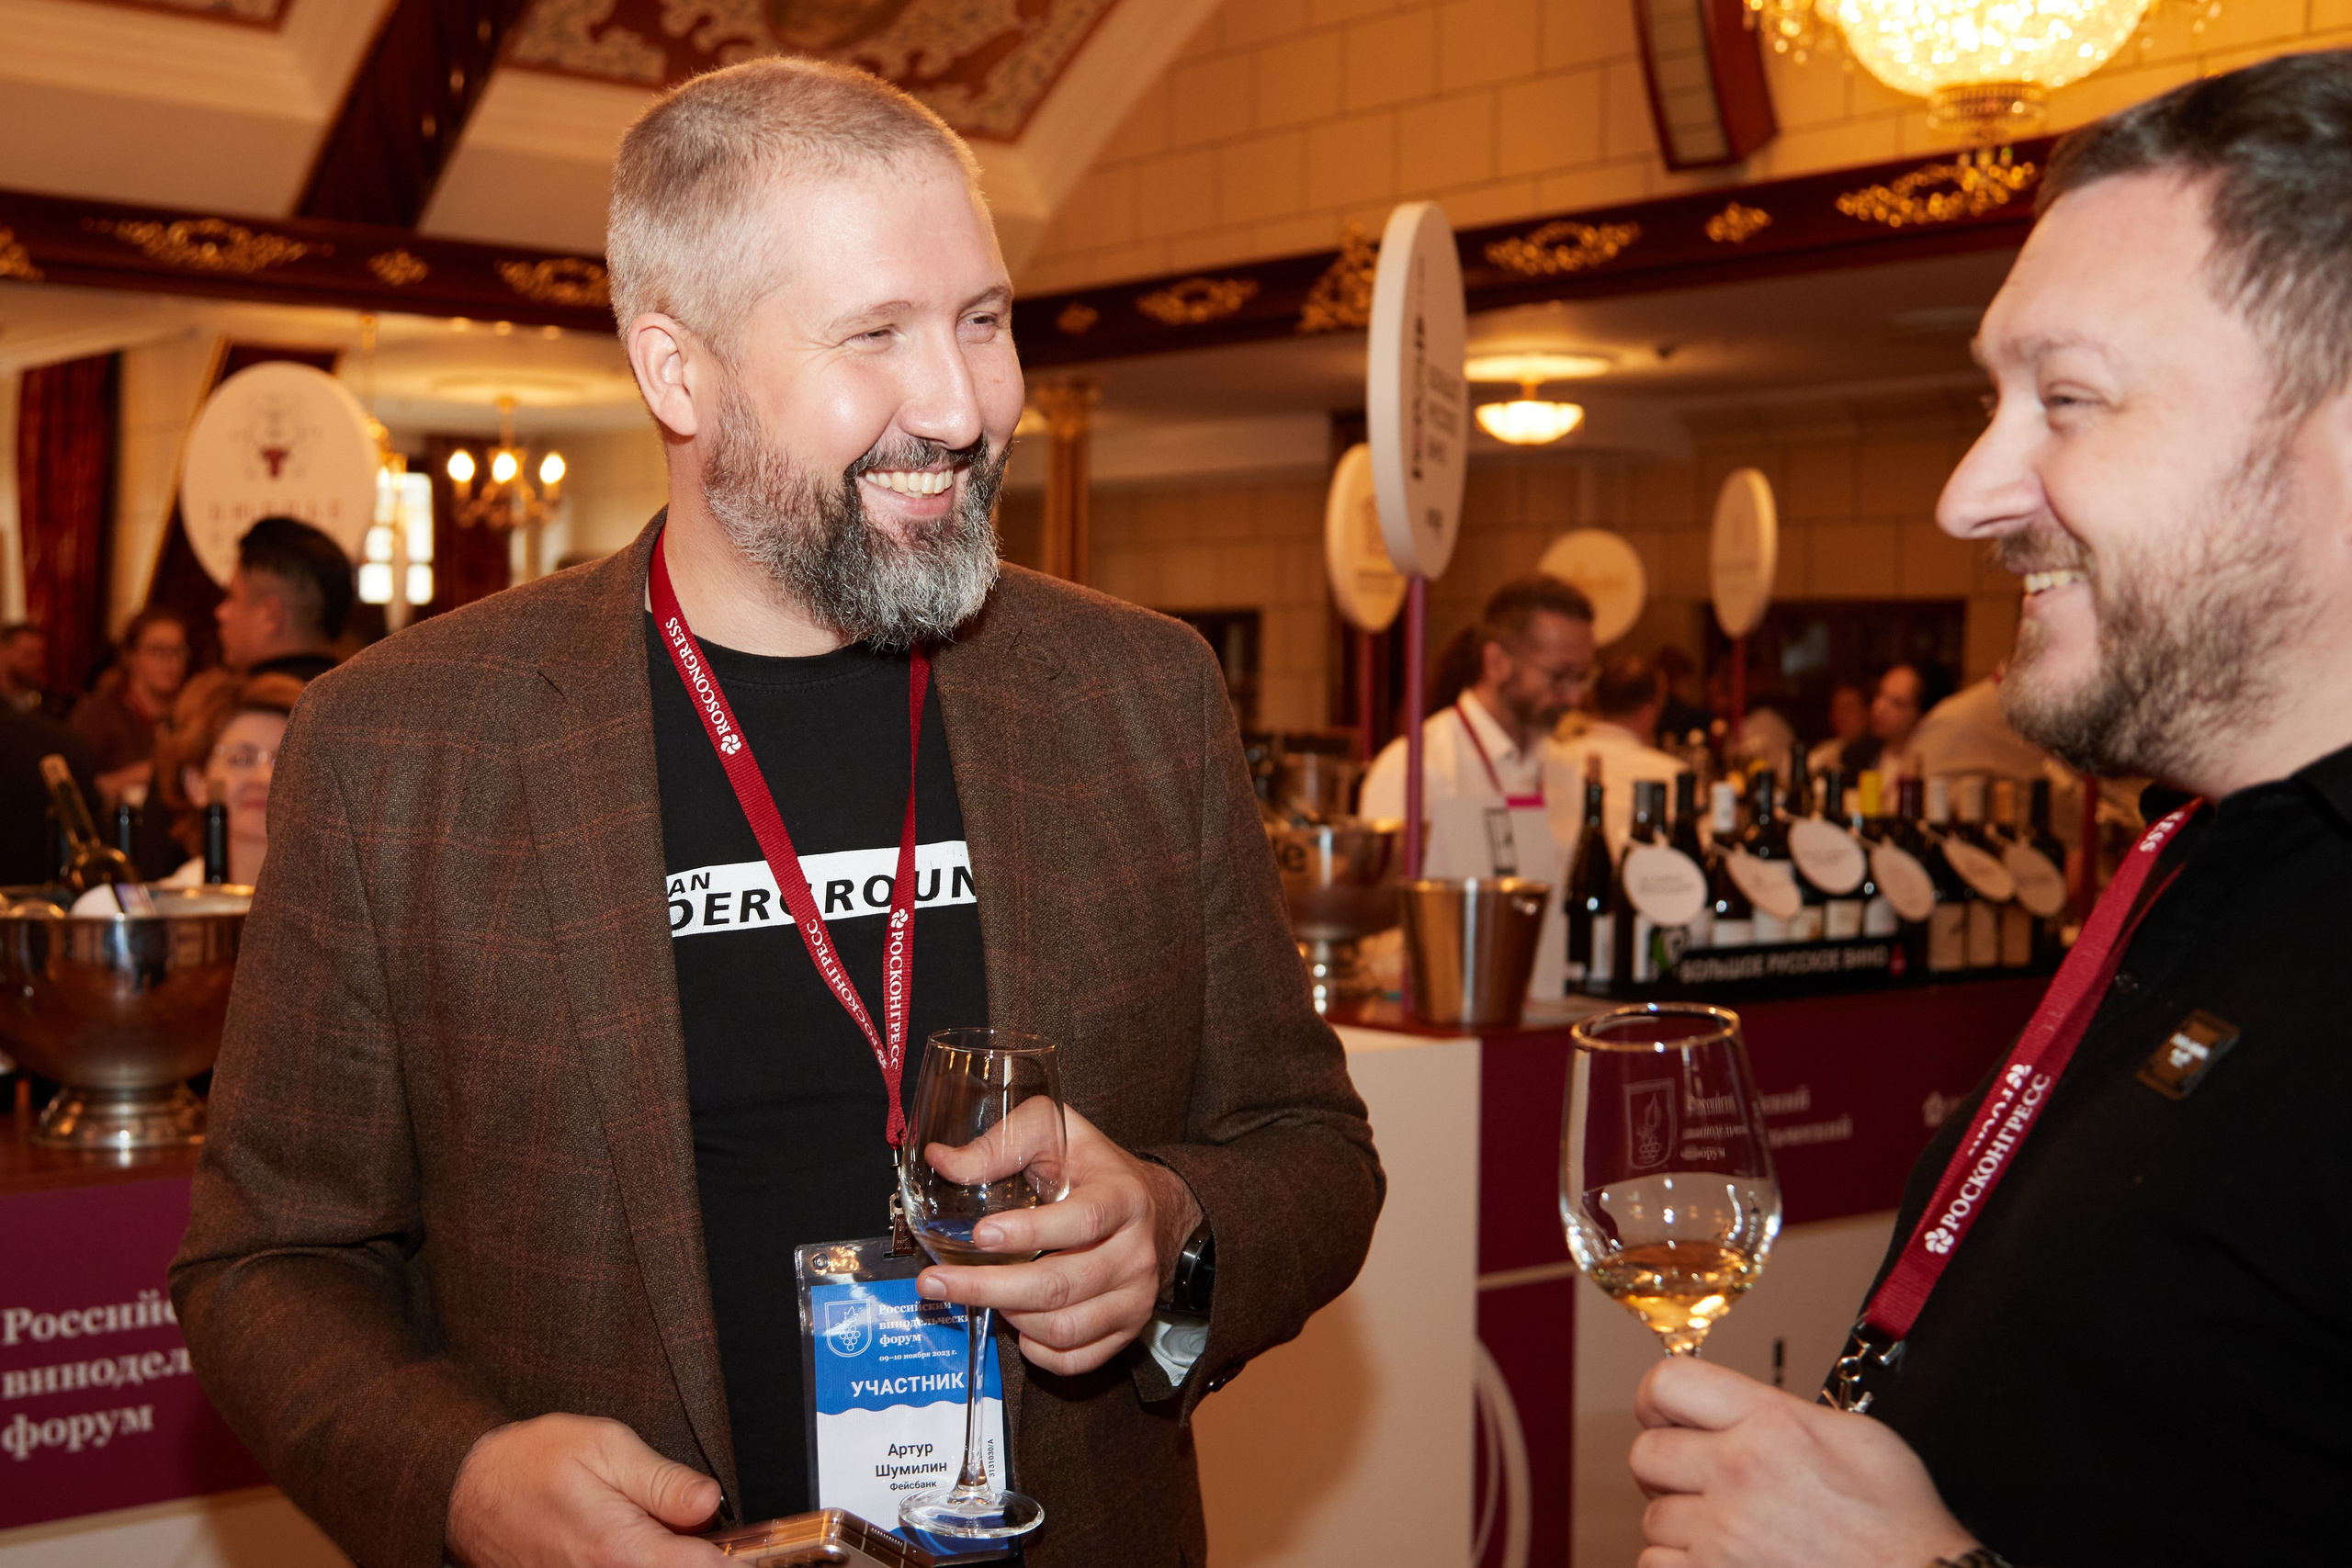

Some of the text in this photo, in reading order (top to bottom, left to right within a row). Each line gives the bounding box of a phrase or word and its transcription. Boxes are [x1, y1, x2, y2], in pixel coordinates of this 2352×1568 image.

[665, 617, 731, 736] ROSCONGRESS
[668, 872, 710, 897] AN
[669, 866, 976, 931] DERROUN
[807, 919, 878, 1047] РОСКОНГРЕСС
[889, 931, 904, 1069] РОСКОНГРЕСС
[1940, 1073, 2051, 1231] РОСКОНГРЕСС
[879, 1334, 922, 1347] форум
[851, 1372, 965, 1397] УЧАСТНИК
[1, 1405, 154, 1461] форум
[888, 1443, 933, 1458] Артур
[876, 1462, 947, 1479] Шумилин
[889, 1481, 937, 1491] Фейсбанк
